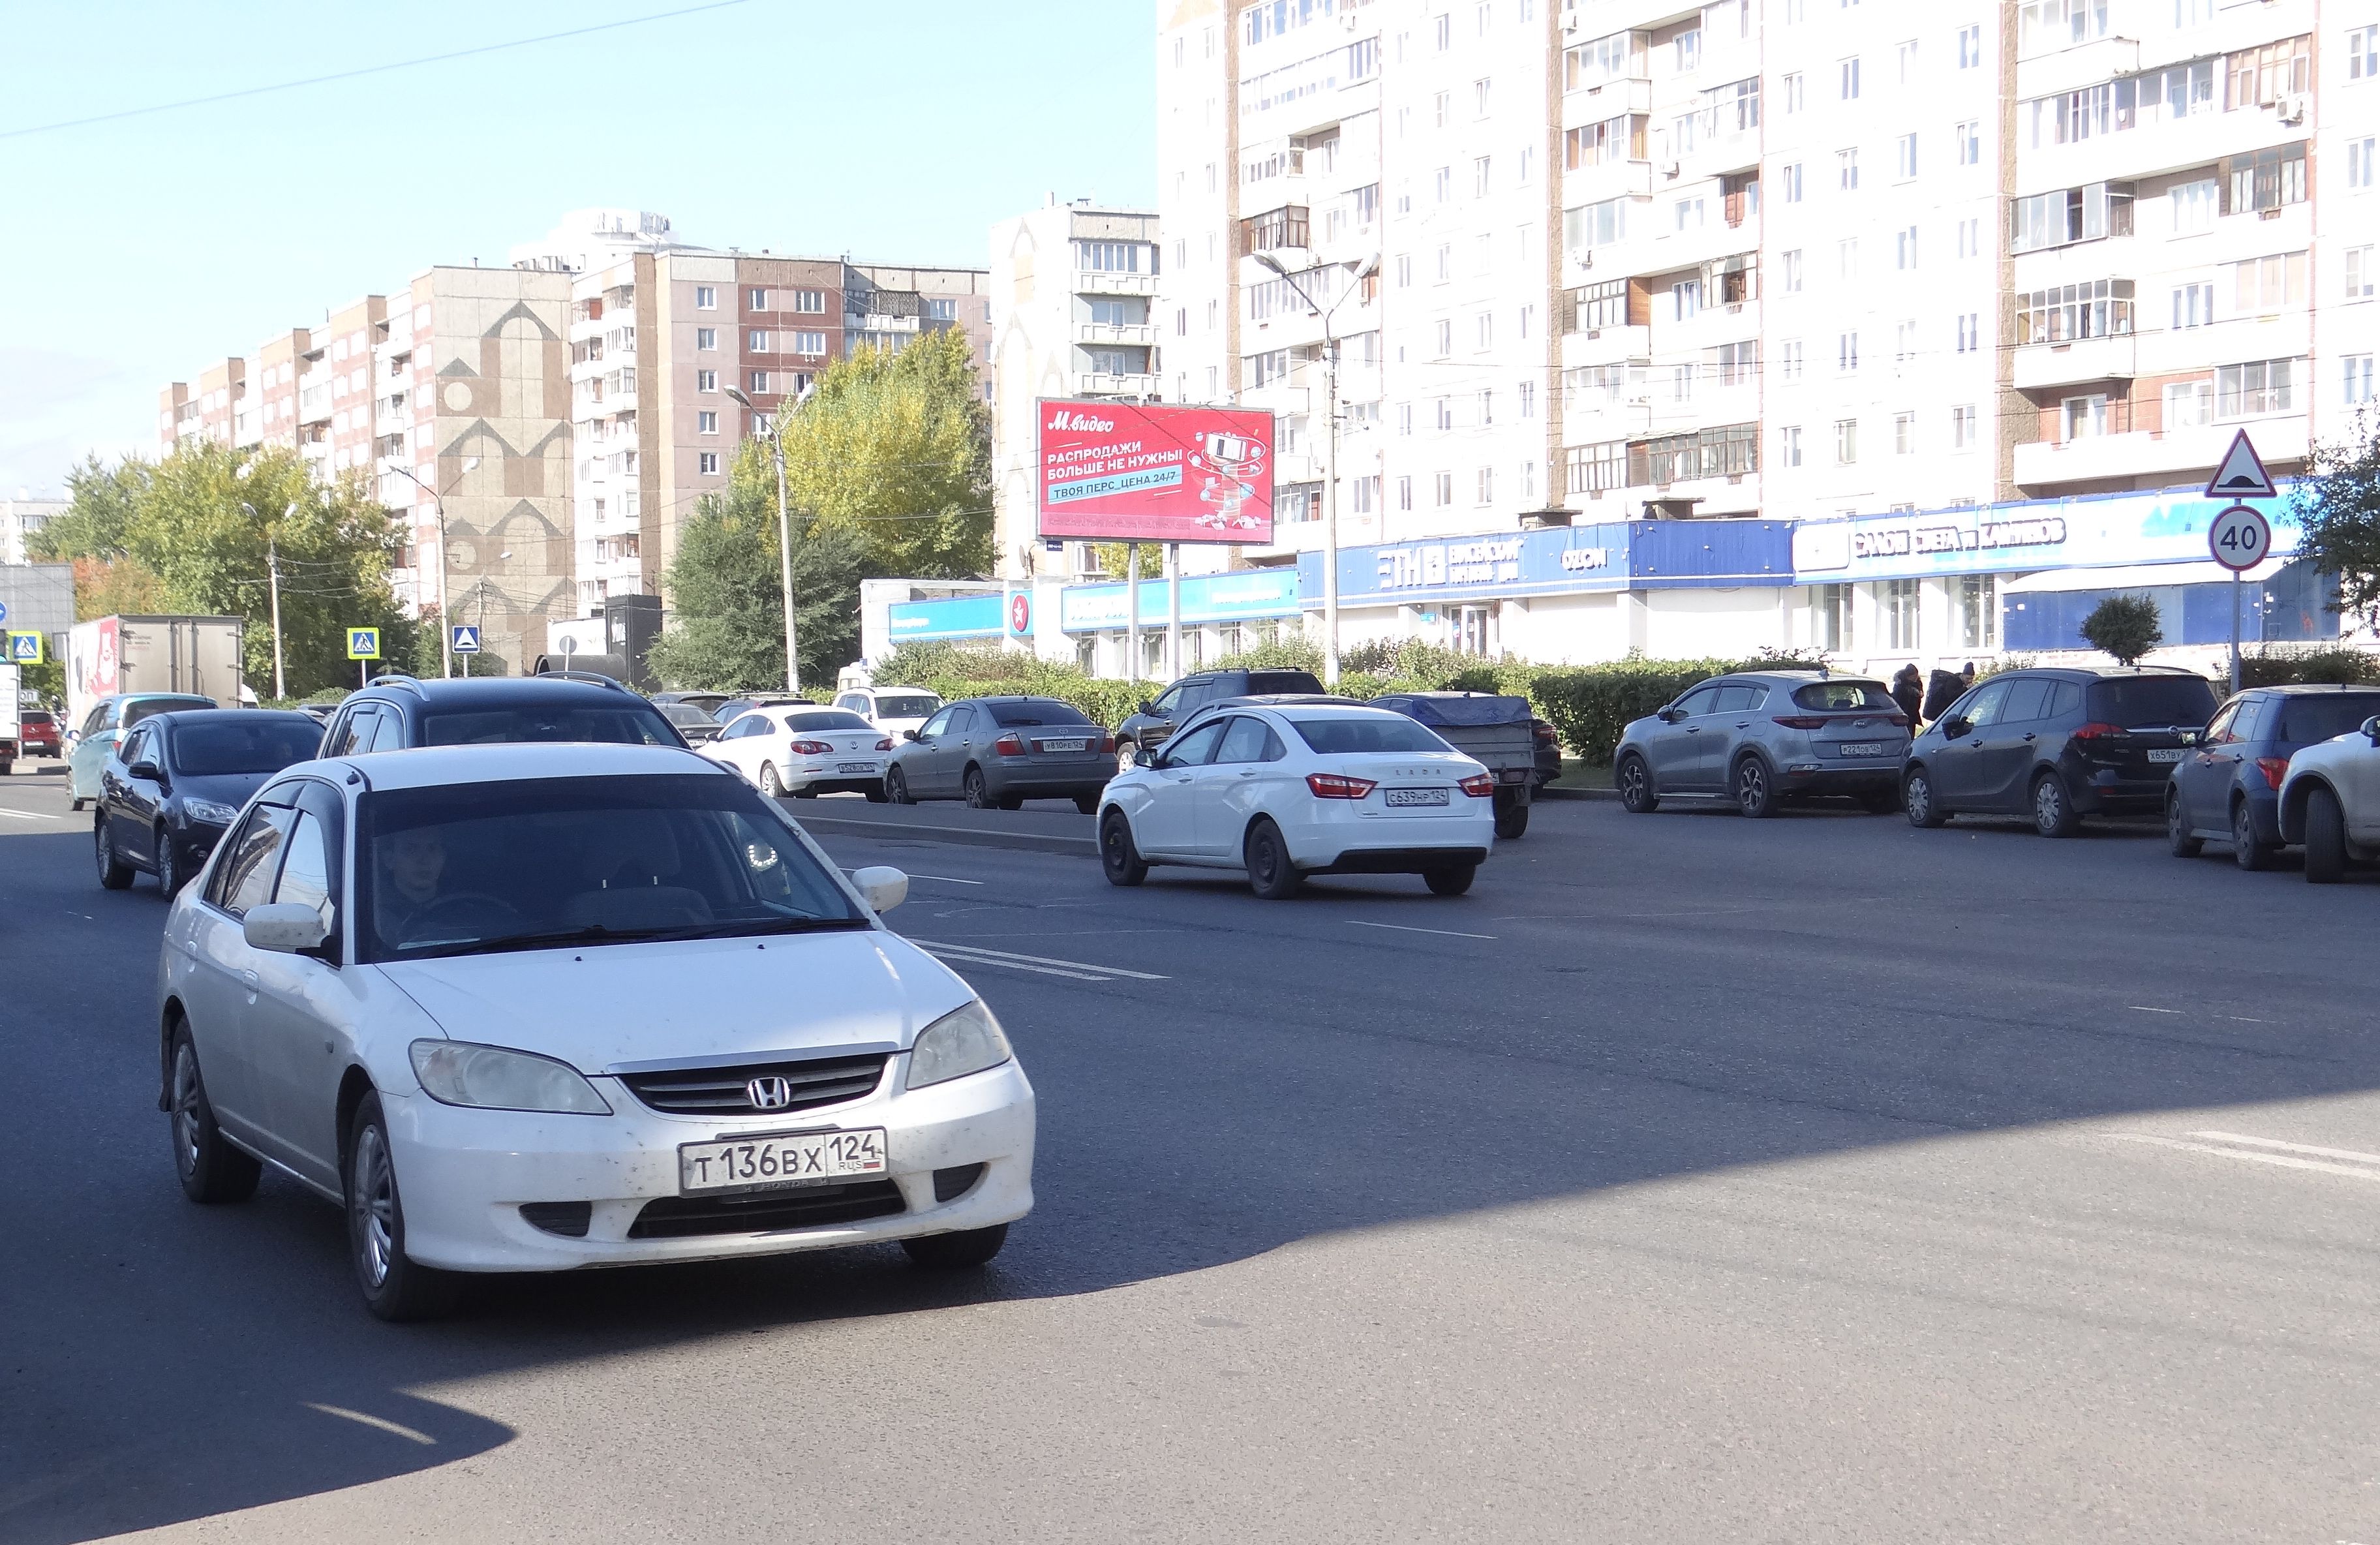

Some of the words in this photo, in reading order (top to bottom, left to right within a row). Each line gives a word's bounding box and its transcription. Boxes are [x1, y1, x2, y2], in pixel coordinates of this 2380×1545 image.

[1048, 410, 1114, 433] М.видео
[1047, 440, 1141, 465] РАСПРОДАЖИ
[1047, 461, 1105, 480] БОЛЬШЕ
[1107, 457, 1125, 471] НЕ
[1127, 449, 1183, 468] НУЖНЫ!
[1054, 486, 1083, 498] ТВОЯ
[1153, 471, 1176, 483] 24/7
[2220, 525, 2257, 550] 40
[1561, 547, 1608, 571] OZON
[695, 1144, 823, 1182] Т136ВХ
[829, 1134, 876, 1161] 124
[839, 1160, 862, 1170] RUS
